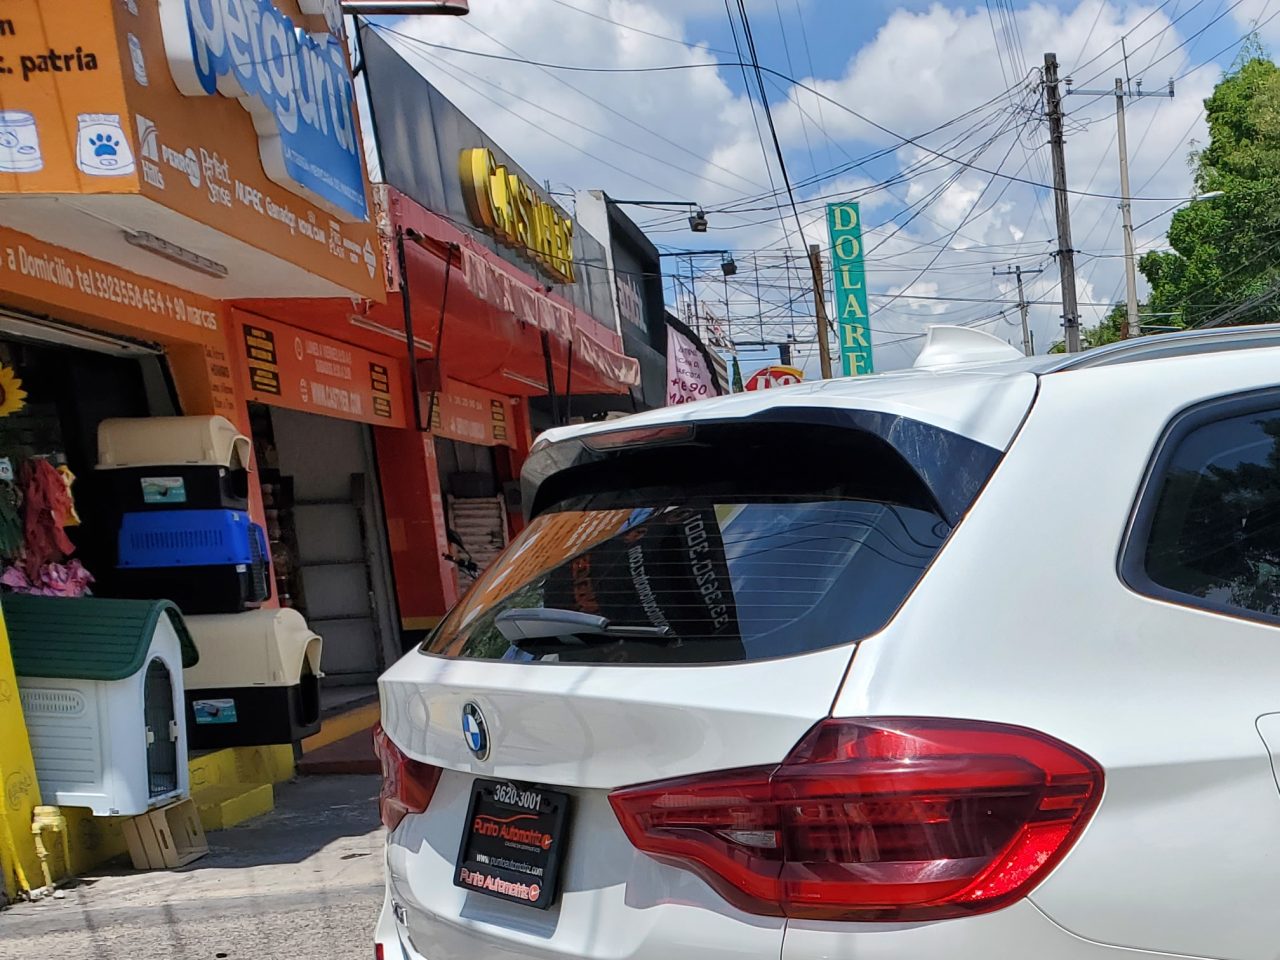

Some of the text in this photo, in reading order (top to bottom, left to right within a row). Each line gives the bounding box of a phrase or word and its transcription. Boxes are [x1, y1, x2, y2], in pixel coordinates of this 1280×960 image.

[20, 46, 98, 82] patria
[7, 248, 16, 271] a
[18, 245, 75, 289] Domicilio
[173, 298, 186, 322] 90
[186, 305, 218, 330] marcas
[494, 784, 542, 811] 3620-3001
[473, 819, 542, 847] Punto Automotriz
[460, 867, 529, 899] Punto Automotriz
